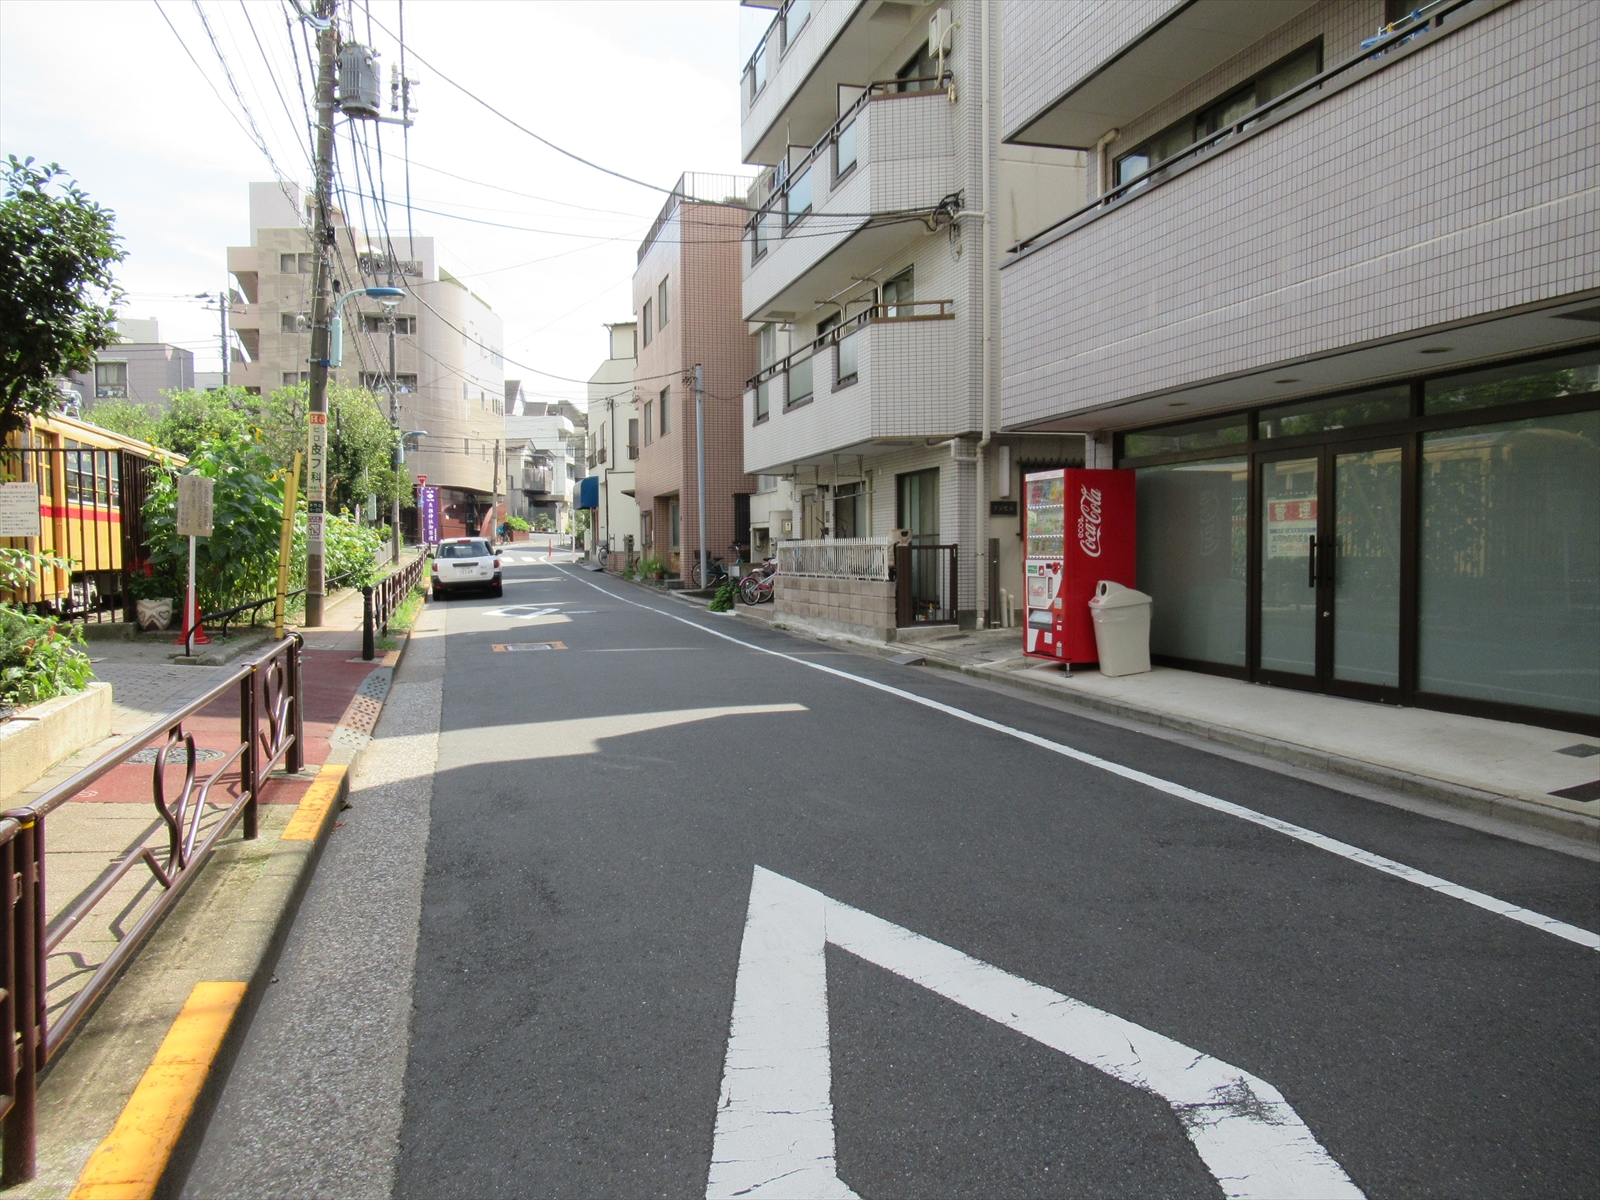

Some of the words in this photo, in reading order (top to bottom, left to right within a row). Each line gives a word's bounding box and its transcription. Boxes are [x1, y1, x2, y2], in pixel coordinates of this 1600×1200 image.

[311, 426, 322, 483] ヒロ皮フ科
[1080, 484, 1102, 558] Coca-Cola
[1274, 502, 1311, 521] 管理
